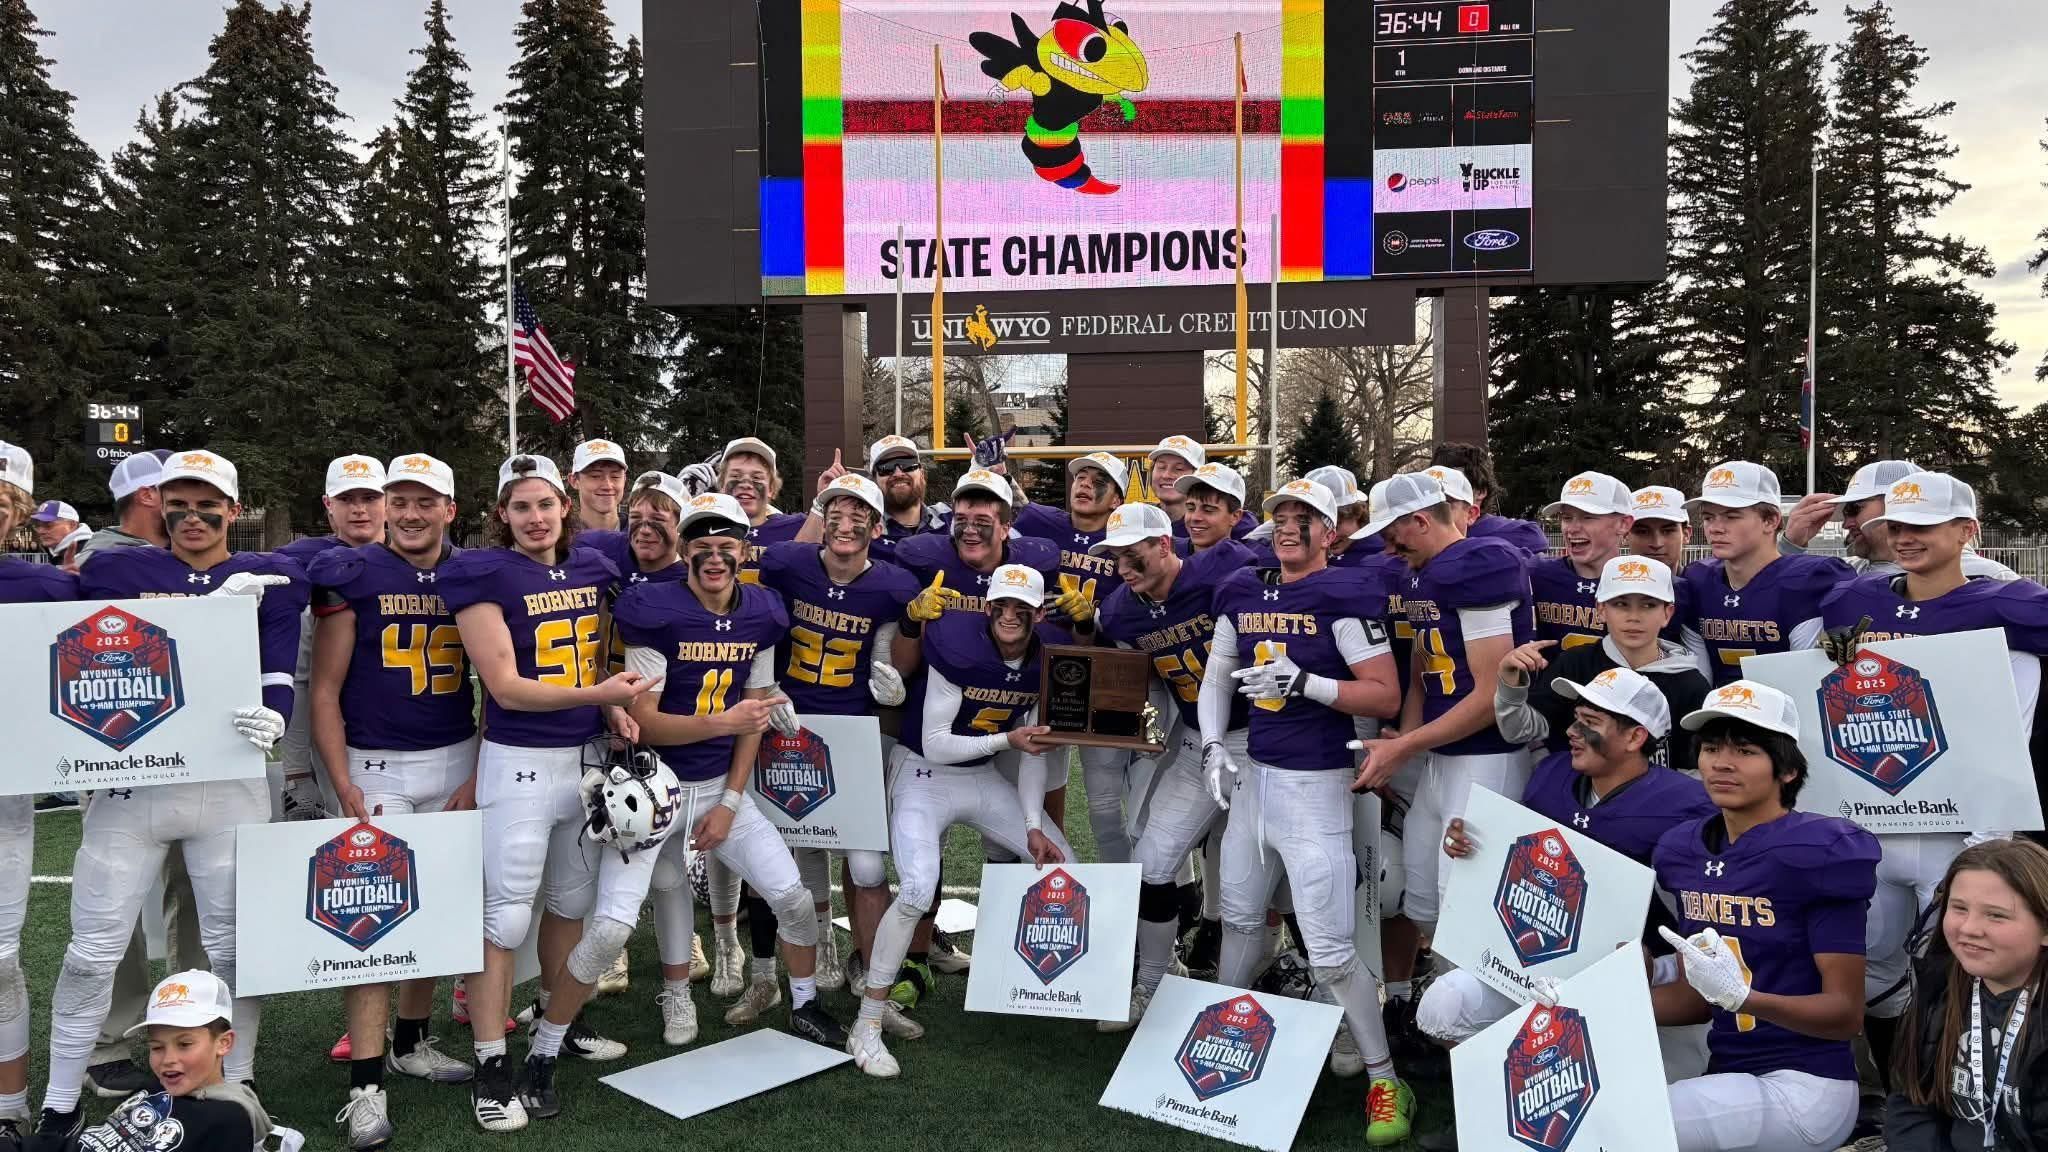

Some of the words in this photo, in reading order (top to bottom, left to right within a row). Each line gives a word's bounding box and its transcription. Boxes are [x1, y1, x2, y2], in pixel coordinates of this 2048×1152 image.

[1378, 11, 1443, 35] 36:44
[1469, 11, 1480, 27] 0
[1398, 50, 1406, 66] 1
[1483, 65, 1507, 73] DISTANCE
[1409, 176, 1440, 187] pepsi
[1474, 167, 1520, 179] BUCKLE
[1474, 180, 1490, 190] UP
[1474, 231, 1509, 247] Ford
[880, 236, 991, 279] STATE
[1002, 229, 1247, 277] CHAMPIONS
[1060, 313, 1172, 336] FEDERAL
[1278, 308, 1368, 330] UNION
[88, 404, 139, 419] 36:44
[115, 423, 128, 442] 0
[523, 587, 598, 616] HORNETS
[793, 599, 872, 635] HORNETS
[1238, 612, 1317, 635] HORNETS
[96, 636, 129, 646] 2025
[101, 652, 127, 663] Ford
[381, 623, 465, 695] 45
[678, 641, 757, 662] HORNETS
[786, 625, 863, 687] 22
[80, 668, 123, 679] WYOMING
[128, 667, 152, 676] STATE
[69, 676, 165, 704] FOOTBALL
[695, 668, 733, 716] 11
[1855, 679, 1886, 689] 2025
[1862, 695, 1886, 705] Ford
[1846, 711, 1885, 722] WYOMING
[1888, 709, 1911, 719] STATE
[1838, 718, 1928, 748] FOOTBALL
[766, 768, 824, 787] FOOTBALL
[348, 848, 377, 858] 2025
[1537, 853, 1560, 871] 2025
[351, 862, 375, 872] Ford
[333, 877, 370, 887] WYOMING
[373, 875, 393, 884] STATE
[1520, 877, 1547, 899] WYOMING
[323, 882, 403, 911] FOOTBALL
[1047, 891, 1065, 899] 2025
[1507, 882, 1569, 938] FOOTBALL
[1025, 924, 1078, 946] FOOTBALL
[1226, 1014, 1249, 1025] 2025
[1532, 1028, 1555, 1049] 2025
[1190, 1039, 1255, 1071] FOOTBALL
[1524, 1065, 1553, 1089] WYOMING
[1555, 1055, 1573, 1073] STATE
[1518, 1062, 1586, 1121] FOOTBALL
